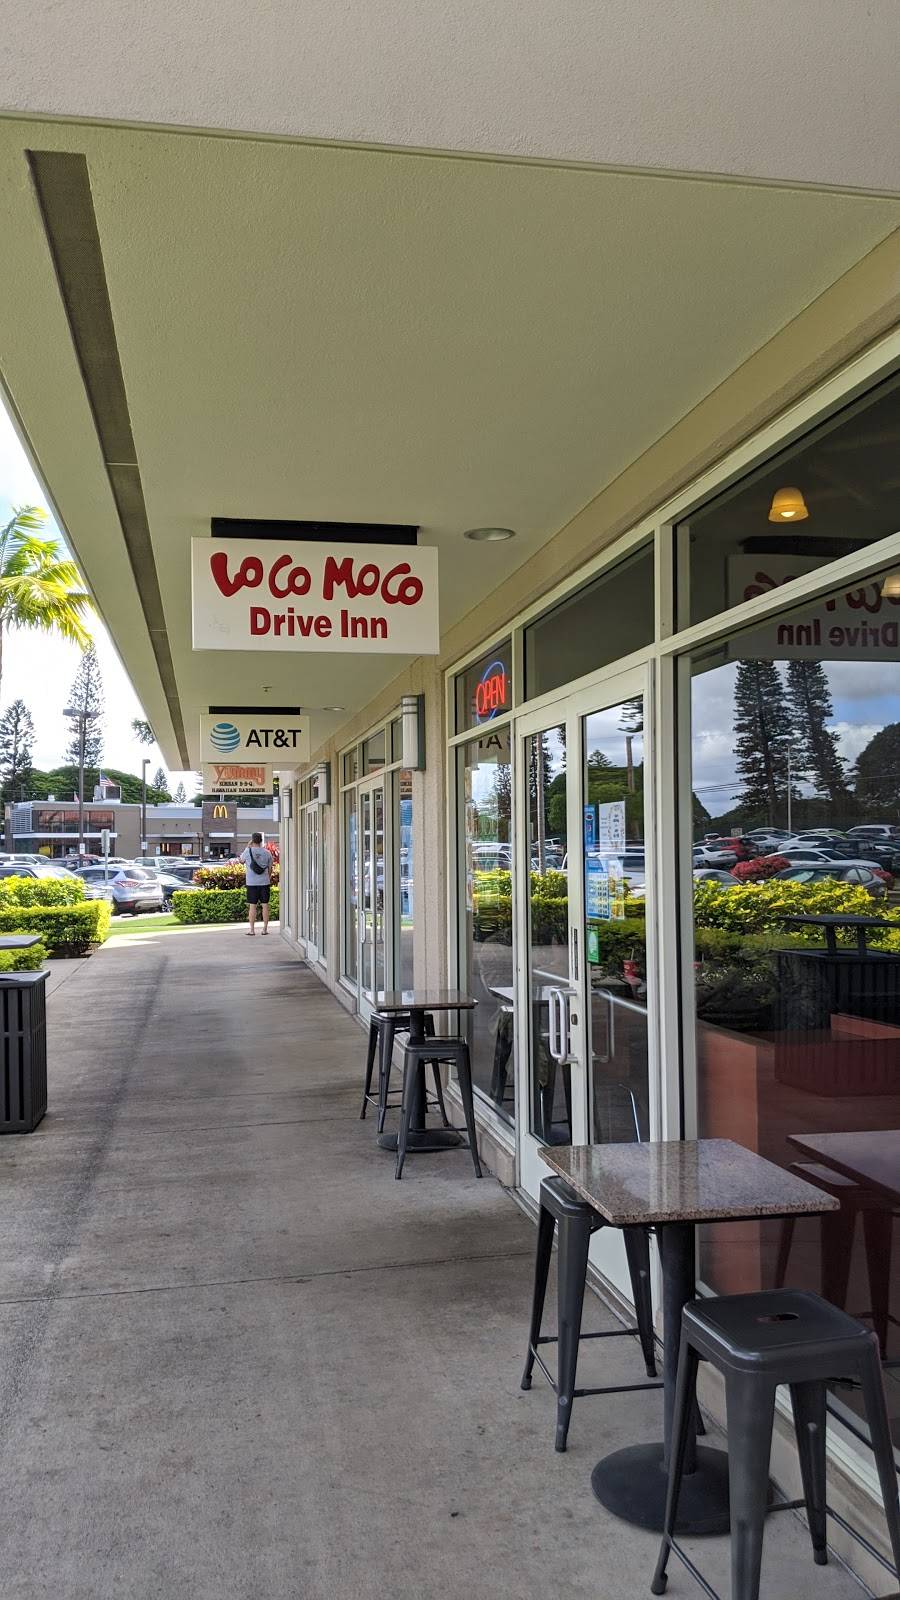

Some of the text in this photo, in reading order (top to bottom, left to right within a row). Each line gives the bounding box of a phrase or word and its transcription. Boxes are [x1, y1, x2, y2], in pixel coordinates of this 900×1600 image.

[250, 606, 388, 639] Drive Inn
[476, 675, 505, 714] OPEN
[245, 729, 302, 748] AT&T
